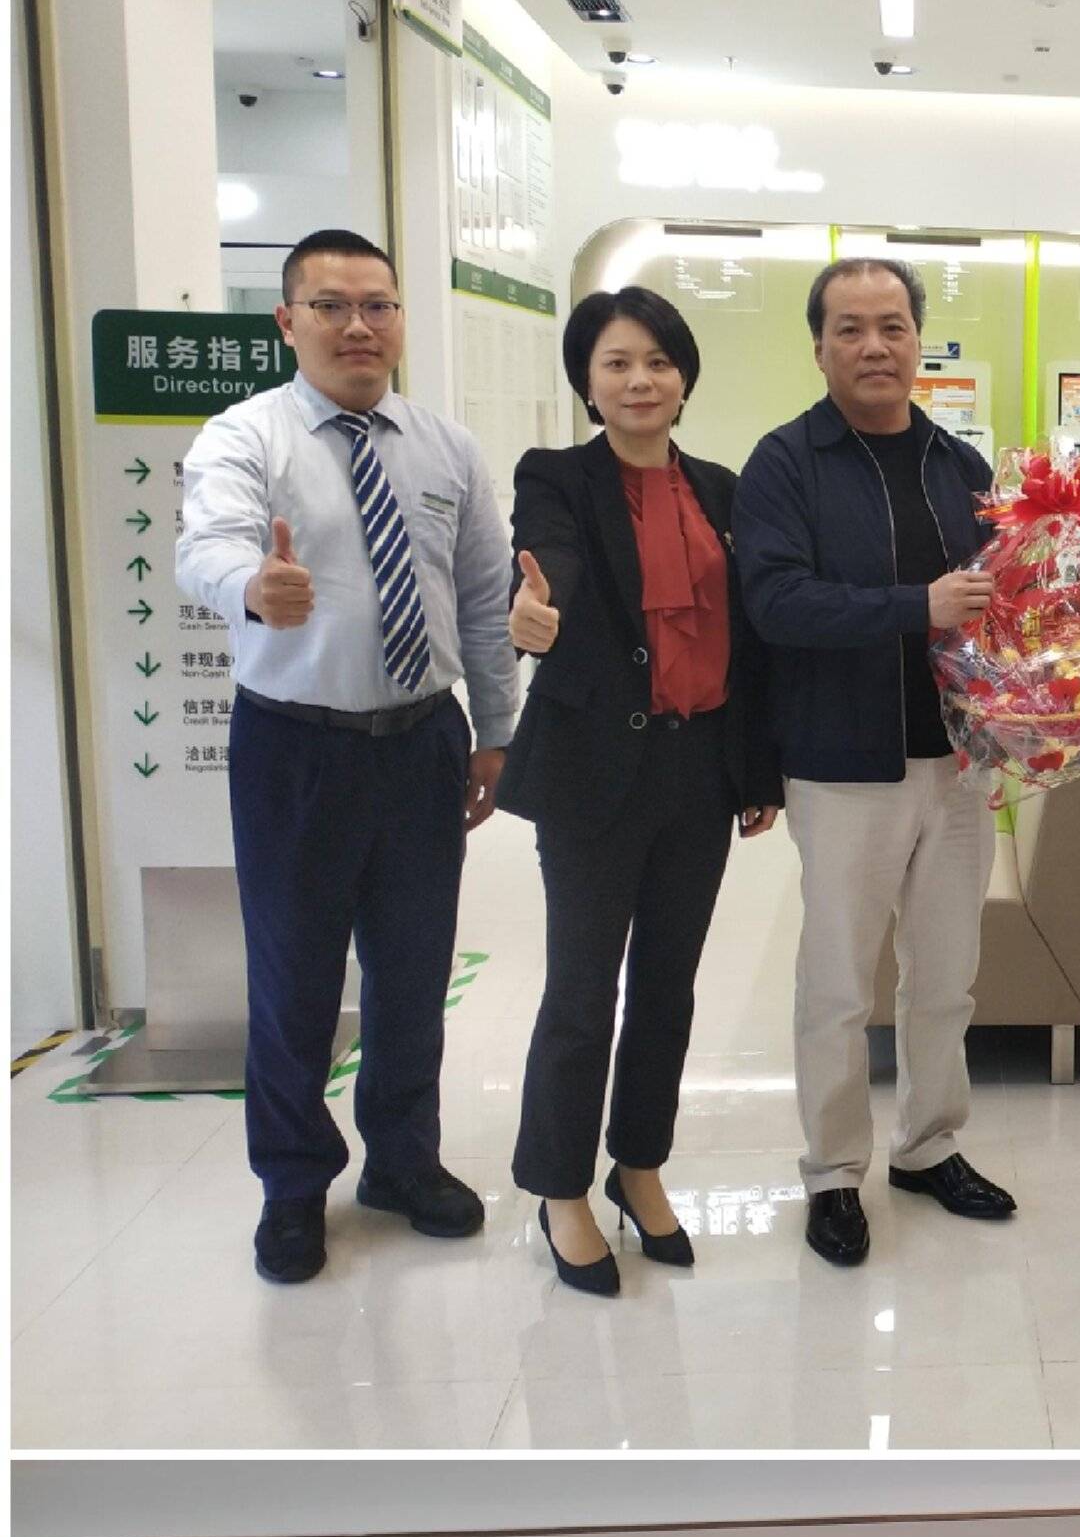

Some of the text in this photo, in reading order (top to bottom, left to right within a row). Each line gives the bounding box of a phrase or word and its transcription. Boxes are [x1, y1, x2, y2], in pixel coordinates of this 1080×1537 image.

[126, 335, 281, 372] 服务指引
[154, 375, 255, 398] Directory
[182, 652, 235, 668] 非现金
